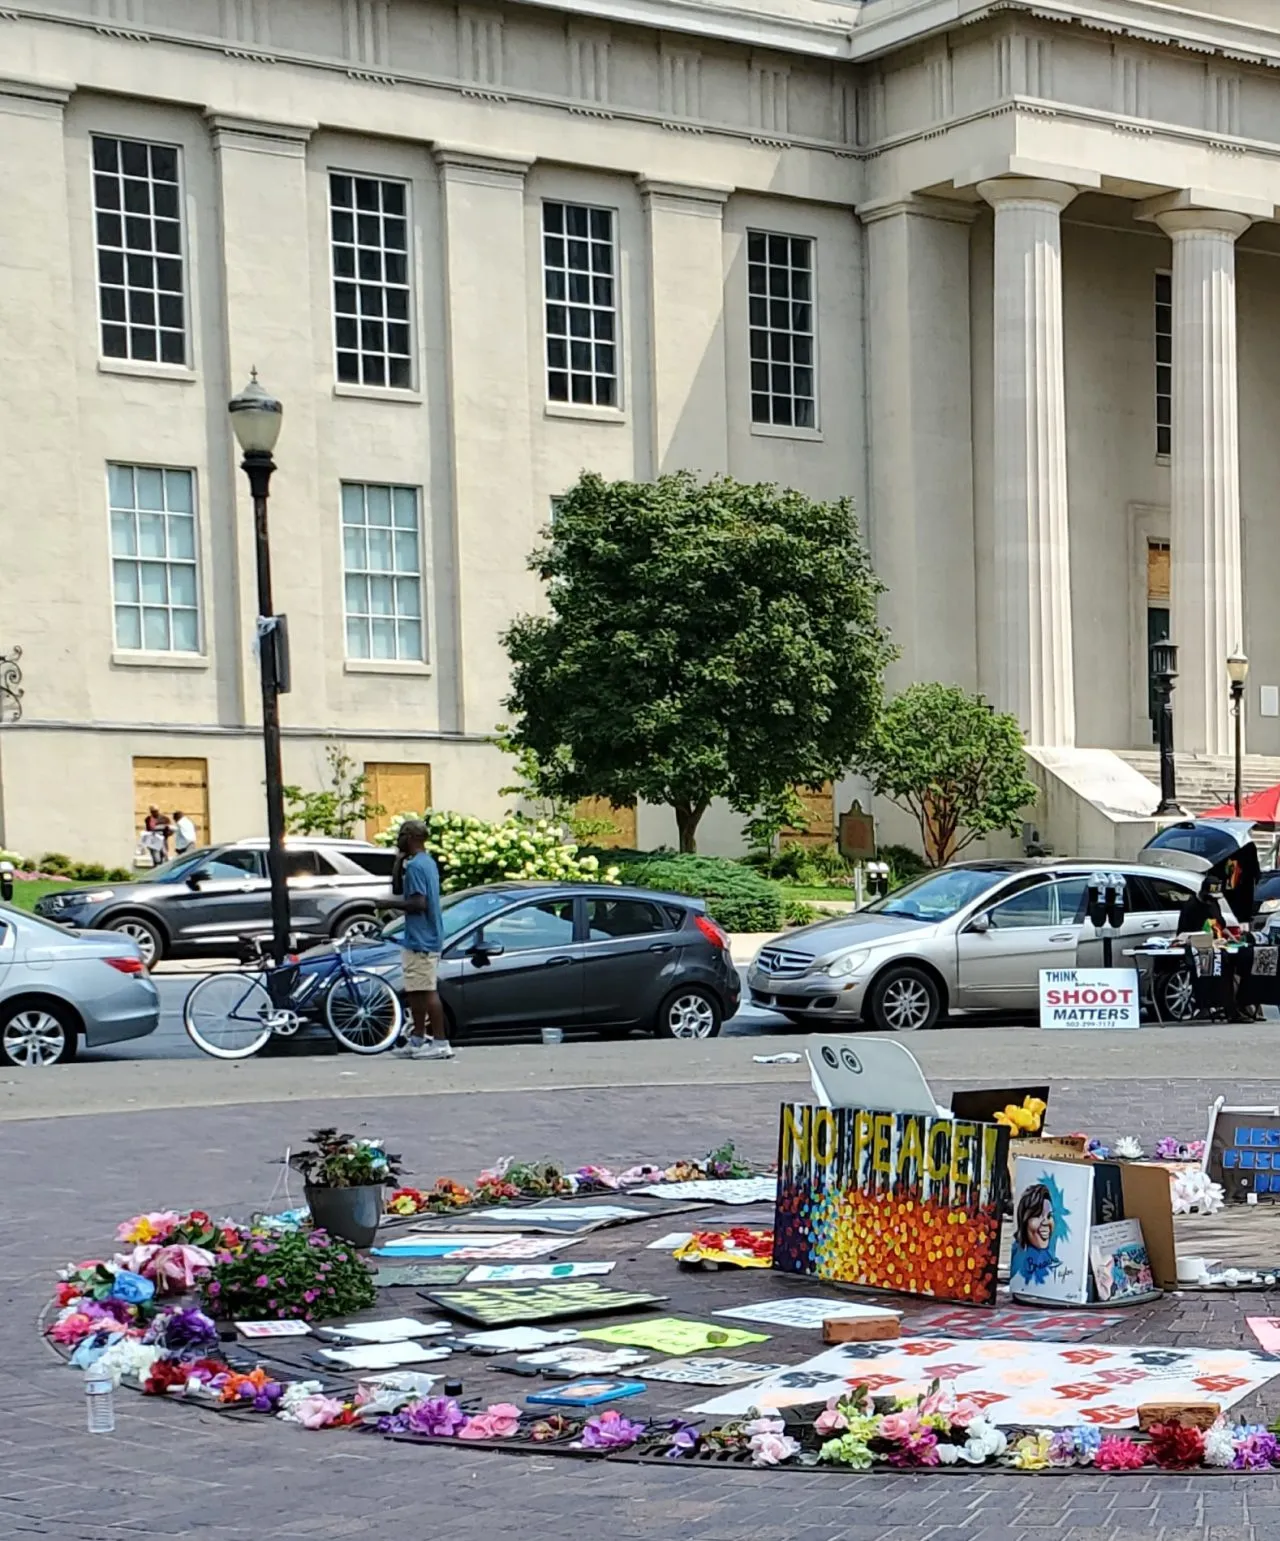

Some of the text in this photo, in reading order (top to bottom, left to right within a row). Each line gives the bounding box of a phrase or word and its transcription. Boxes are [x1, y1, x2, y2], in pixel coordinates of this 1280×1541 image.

[1045, 970, 1078, 983] THINK
[1046, 988, 1134, 1005] SHOOT
[1053, 1008, 1130, 1021] MATTERS
[782, 1105, 839, 1168] NO
